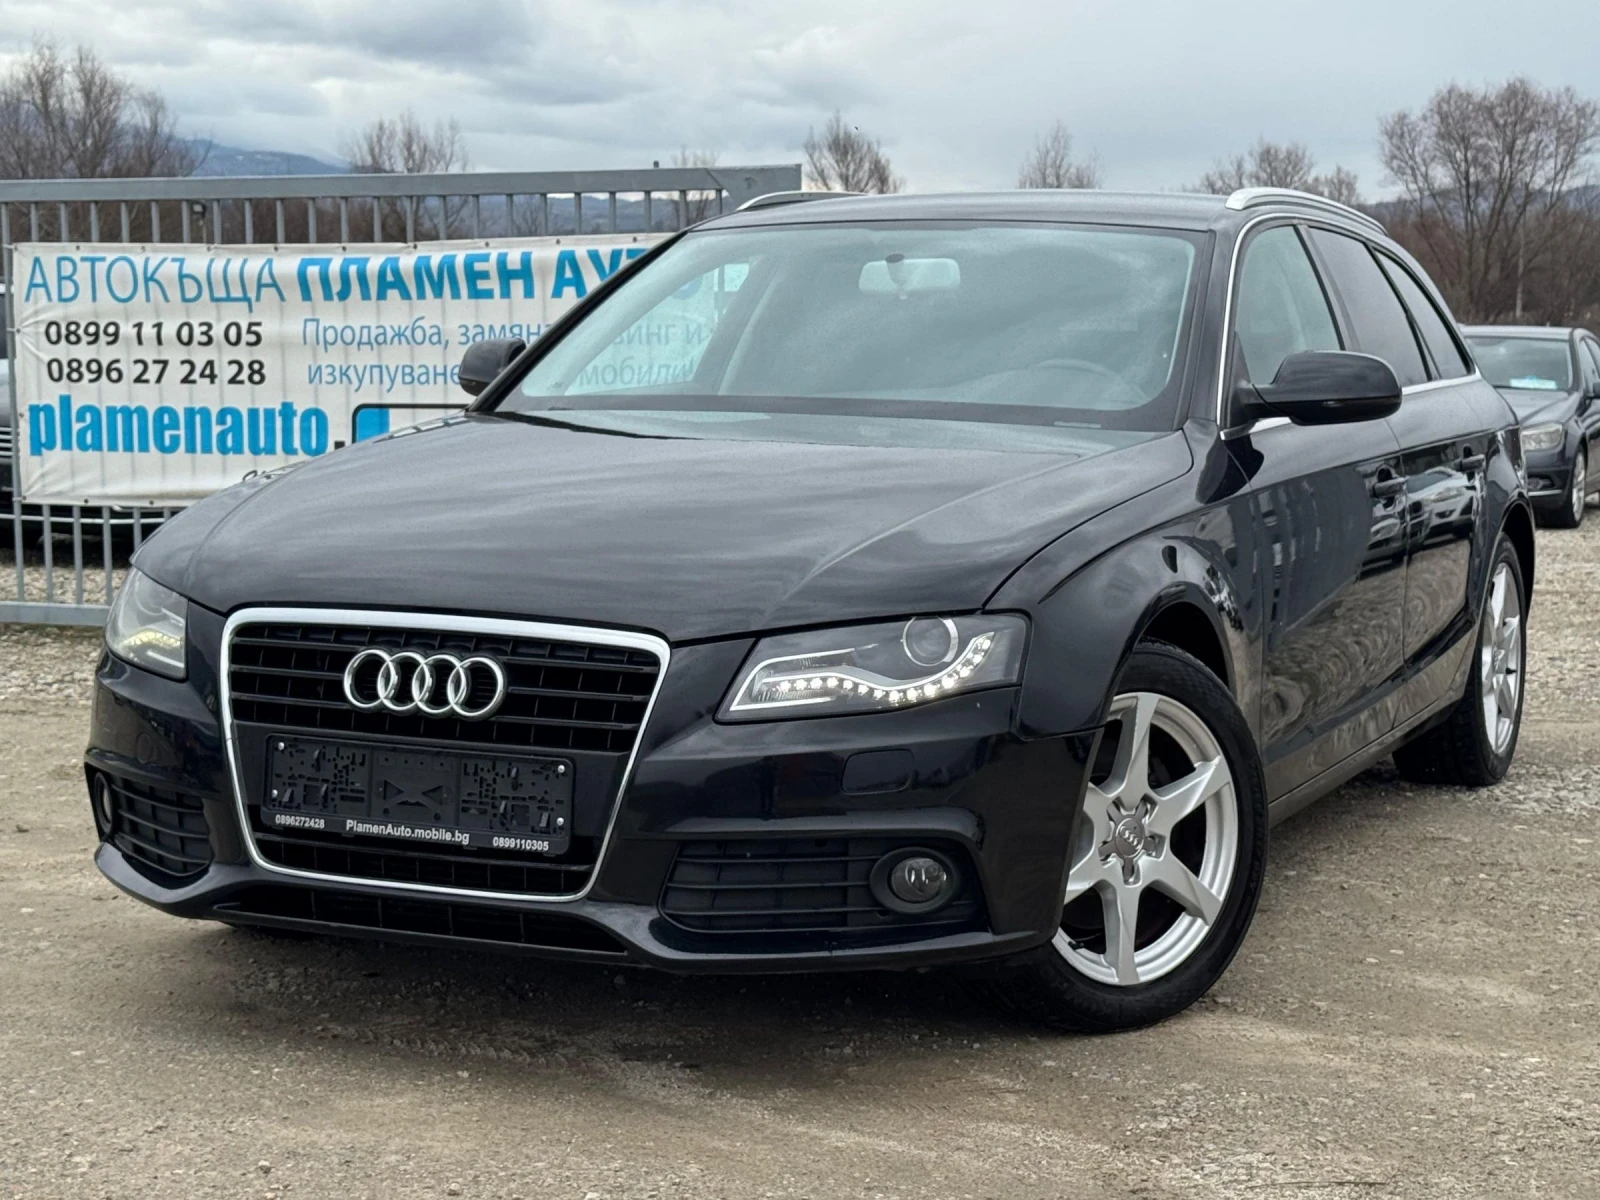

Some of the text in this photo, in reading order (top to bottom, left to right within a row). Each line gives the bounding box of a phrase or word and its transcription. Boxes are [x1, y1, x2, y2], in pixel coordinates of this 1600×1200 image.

[25, 256, 286, 313] АВТОКЪЩА
[297, 250, 536, 300] ПЛАМЕН
[45, 321, 262, 346] 0899 11 03 05
[302, 316, 449, 352] Продажба,
[458, 324, 555, 345] замян
[47, 358, 266, 385] 0896 27 24 28
[346, 818, 470, 845] PlamenAuto.mobile.bg
